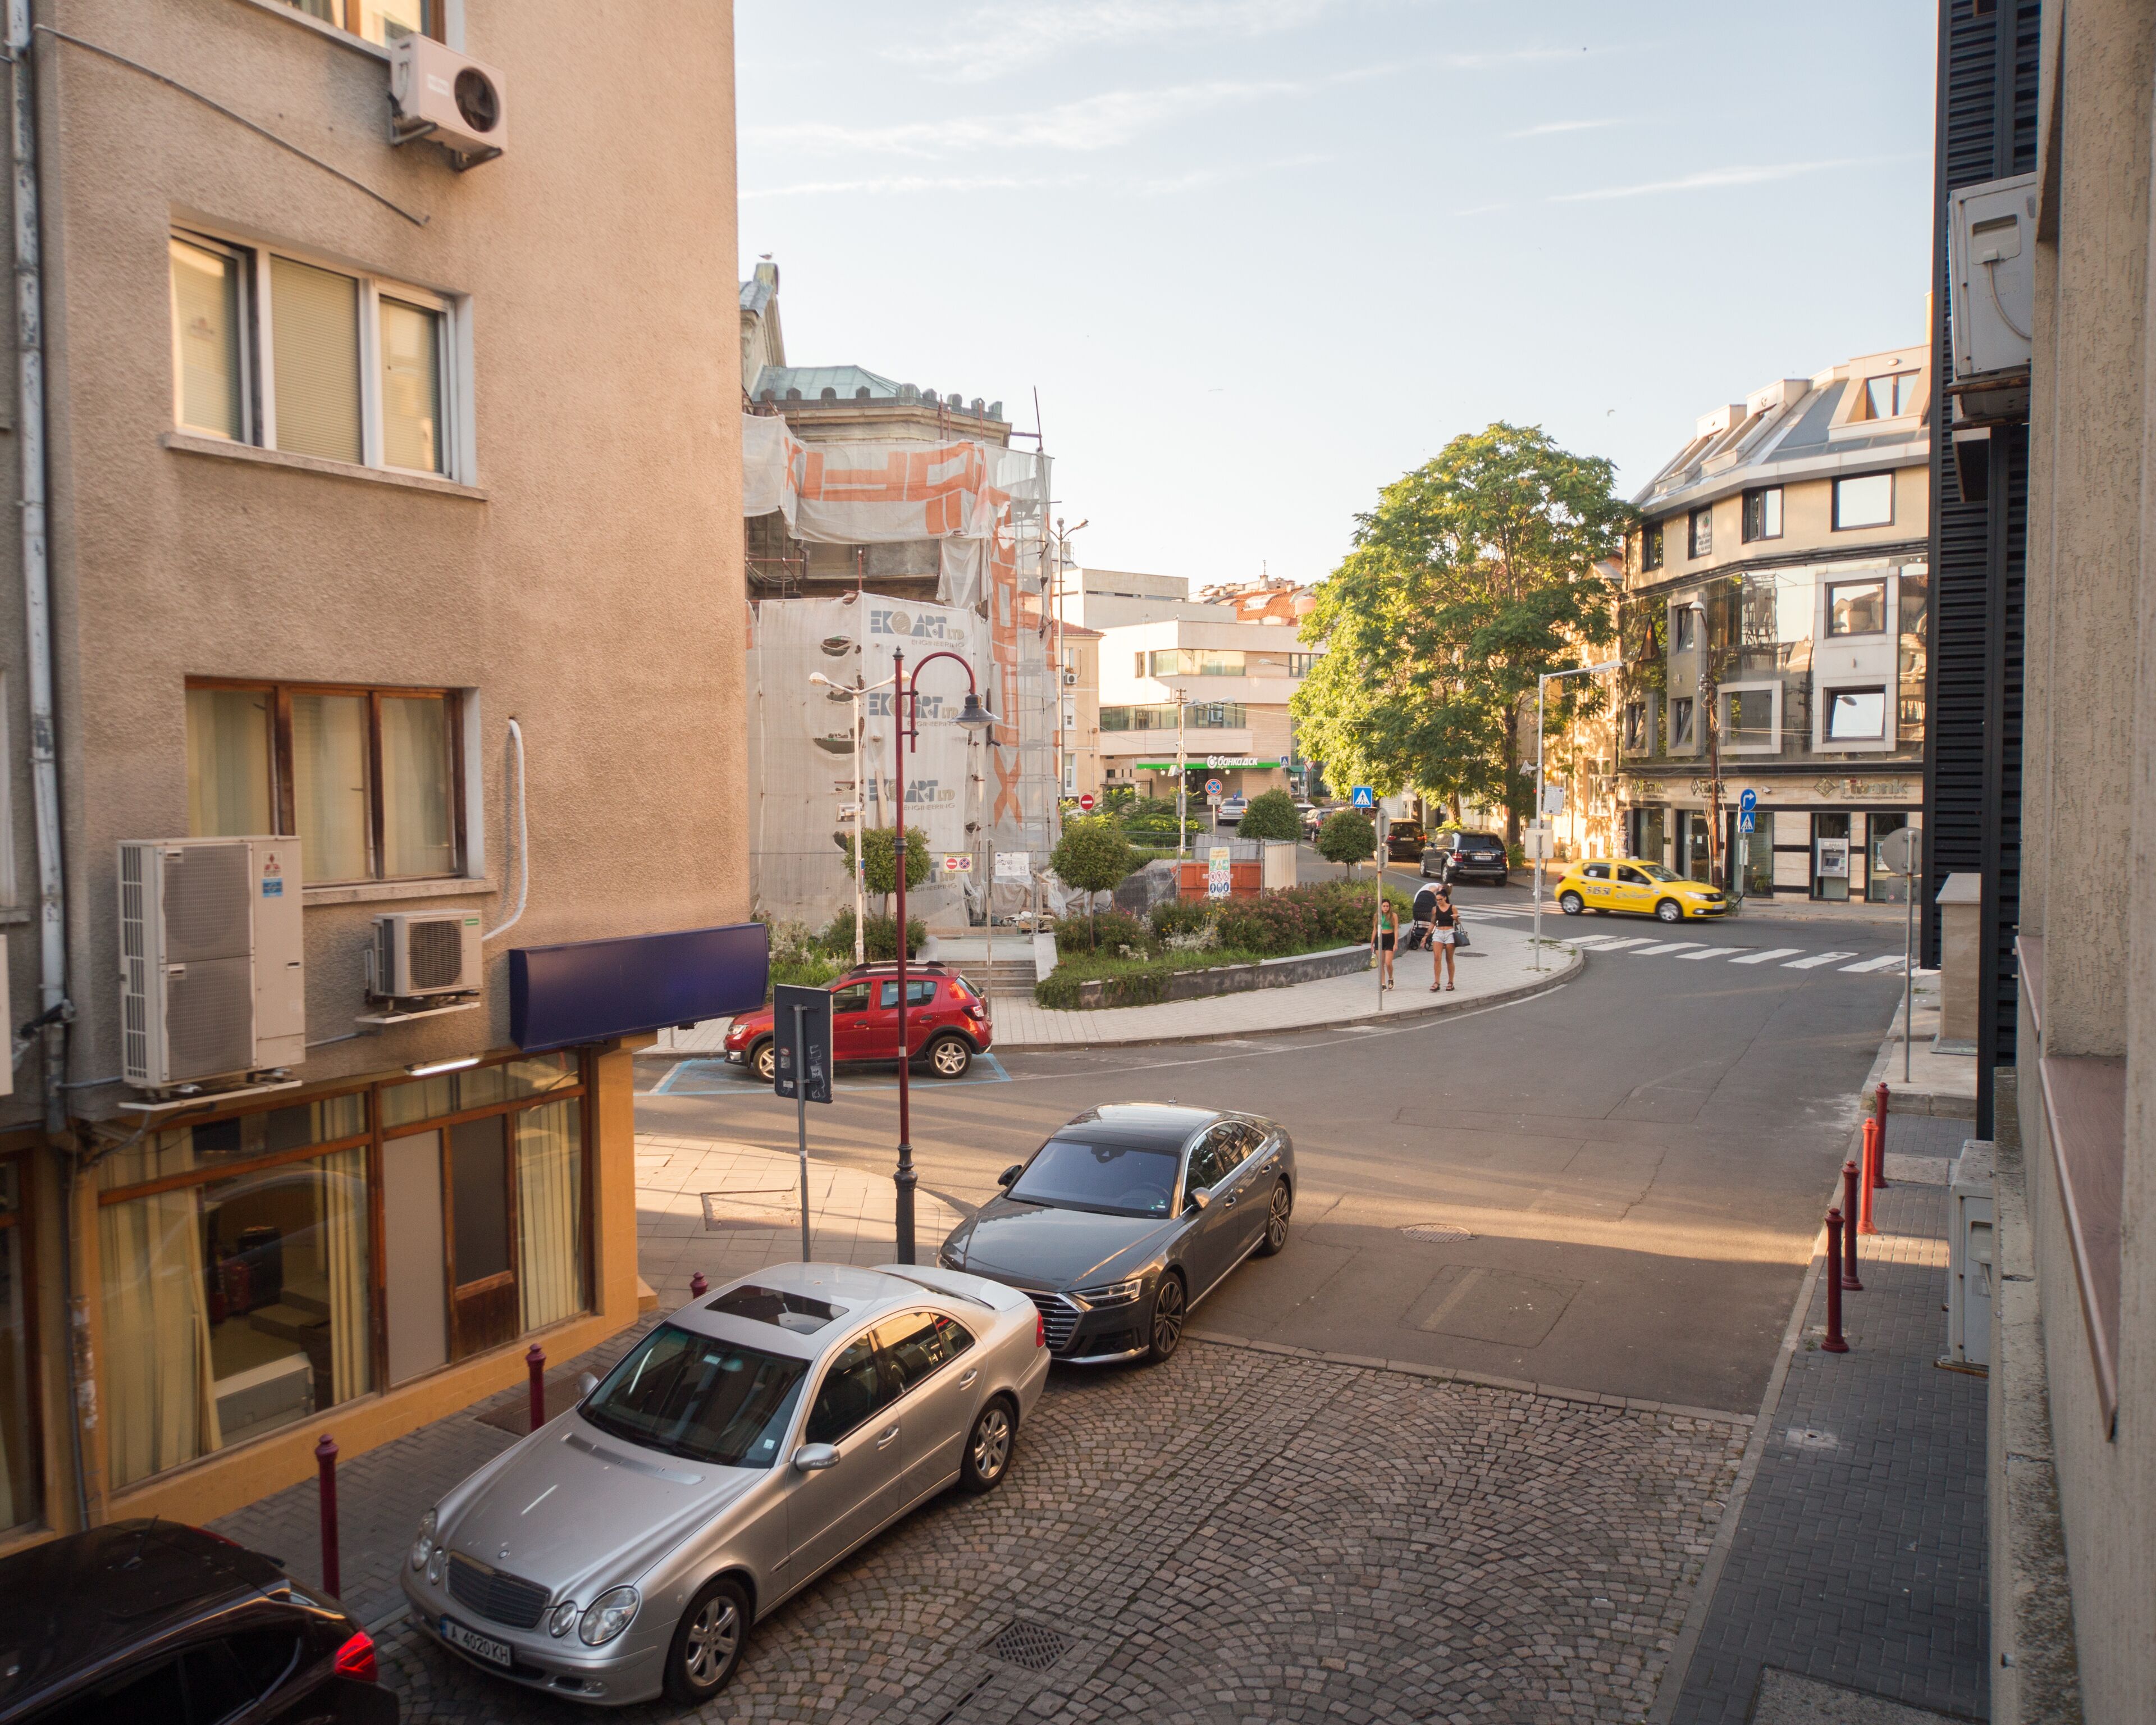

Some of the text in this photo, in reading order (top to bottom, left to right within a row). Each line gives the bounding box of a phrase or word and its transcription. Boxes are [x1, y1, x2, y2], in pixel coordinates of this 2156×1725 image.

[947, 628, 965, 640] LTD
[911, 639, 965, 647] ENGINEERING
[942, 707, 959, 719] LTD
[1839, 778, 1908, 795] Fibank
[937, 789, 956, 801] LTD
[451, 1626, 458, 1641] A
[463, 1632, 490, 1655] 4020
[492, 1644, 509, 1663] KH
